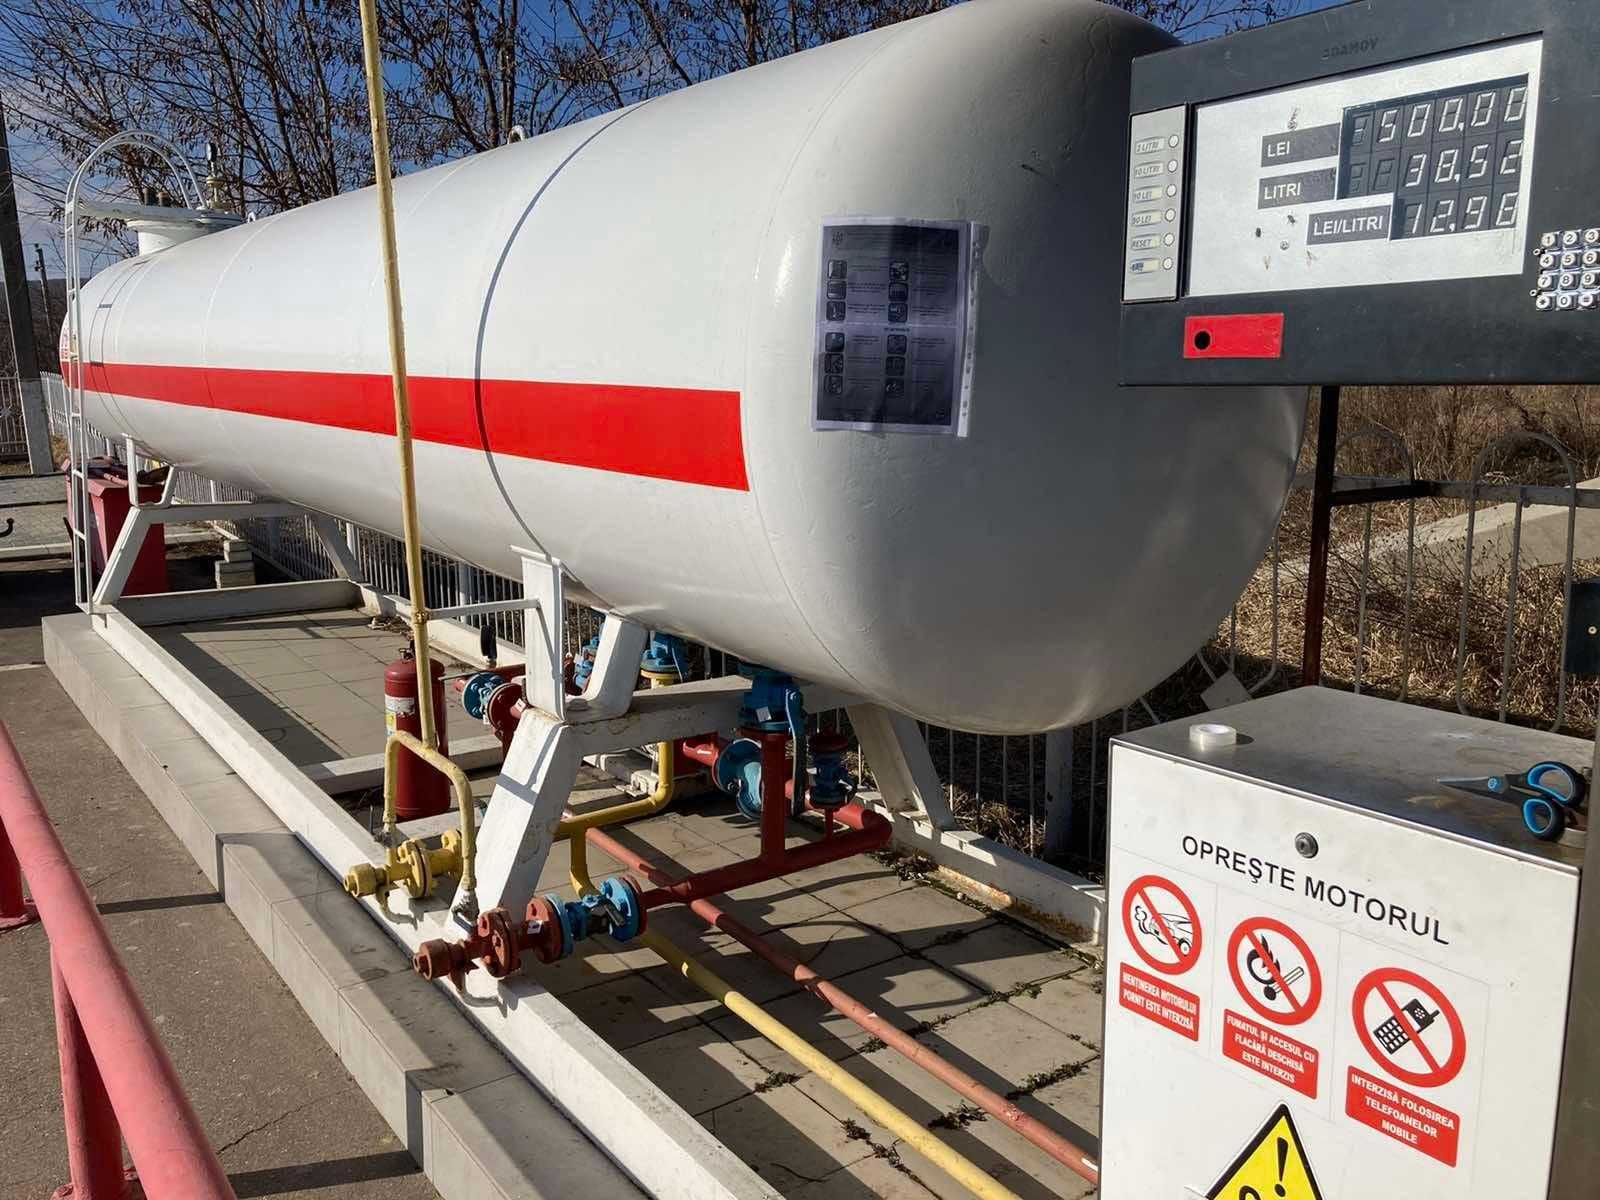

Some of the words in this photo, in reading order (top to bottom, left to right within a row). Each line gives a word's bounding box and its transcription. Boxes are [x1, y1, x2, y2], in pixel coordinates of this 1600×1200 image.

[1266, 140, 1291, 158] LEI
[1263, 182, 1302, 200] LITRI
[1312, 215, 1384, 236] LEI/LITRI
[1304, 876, 1450, 946] MOTORUL
[1145, 999, 1162, 1016] ESTE
[1226, 1014, 1259, 1037] FUMATUL
[1268, 1034, 1303, 1058] ACCESUL
[1303, 1050, 1316, 1063] CU
[1241, 1050, 1261, 1067] ESTE
[1261, 1059, 1296, 1084] INTERZIS
[1364, 1095, 1438, 1138] TELEFOANELOR
[1400, 1097, 1456, 1130] FOLOSIREA
[1381, 1119, 1419, 1144] MOBILE
